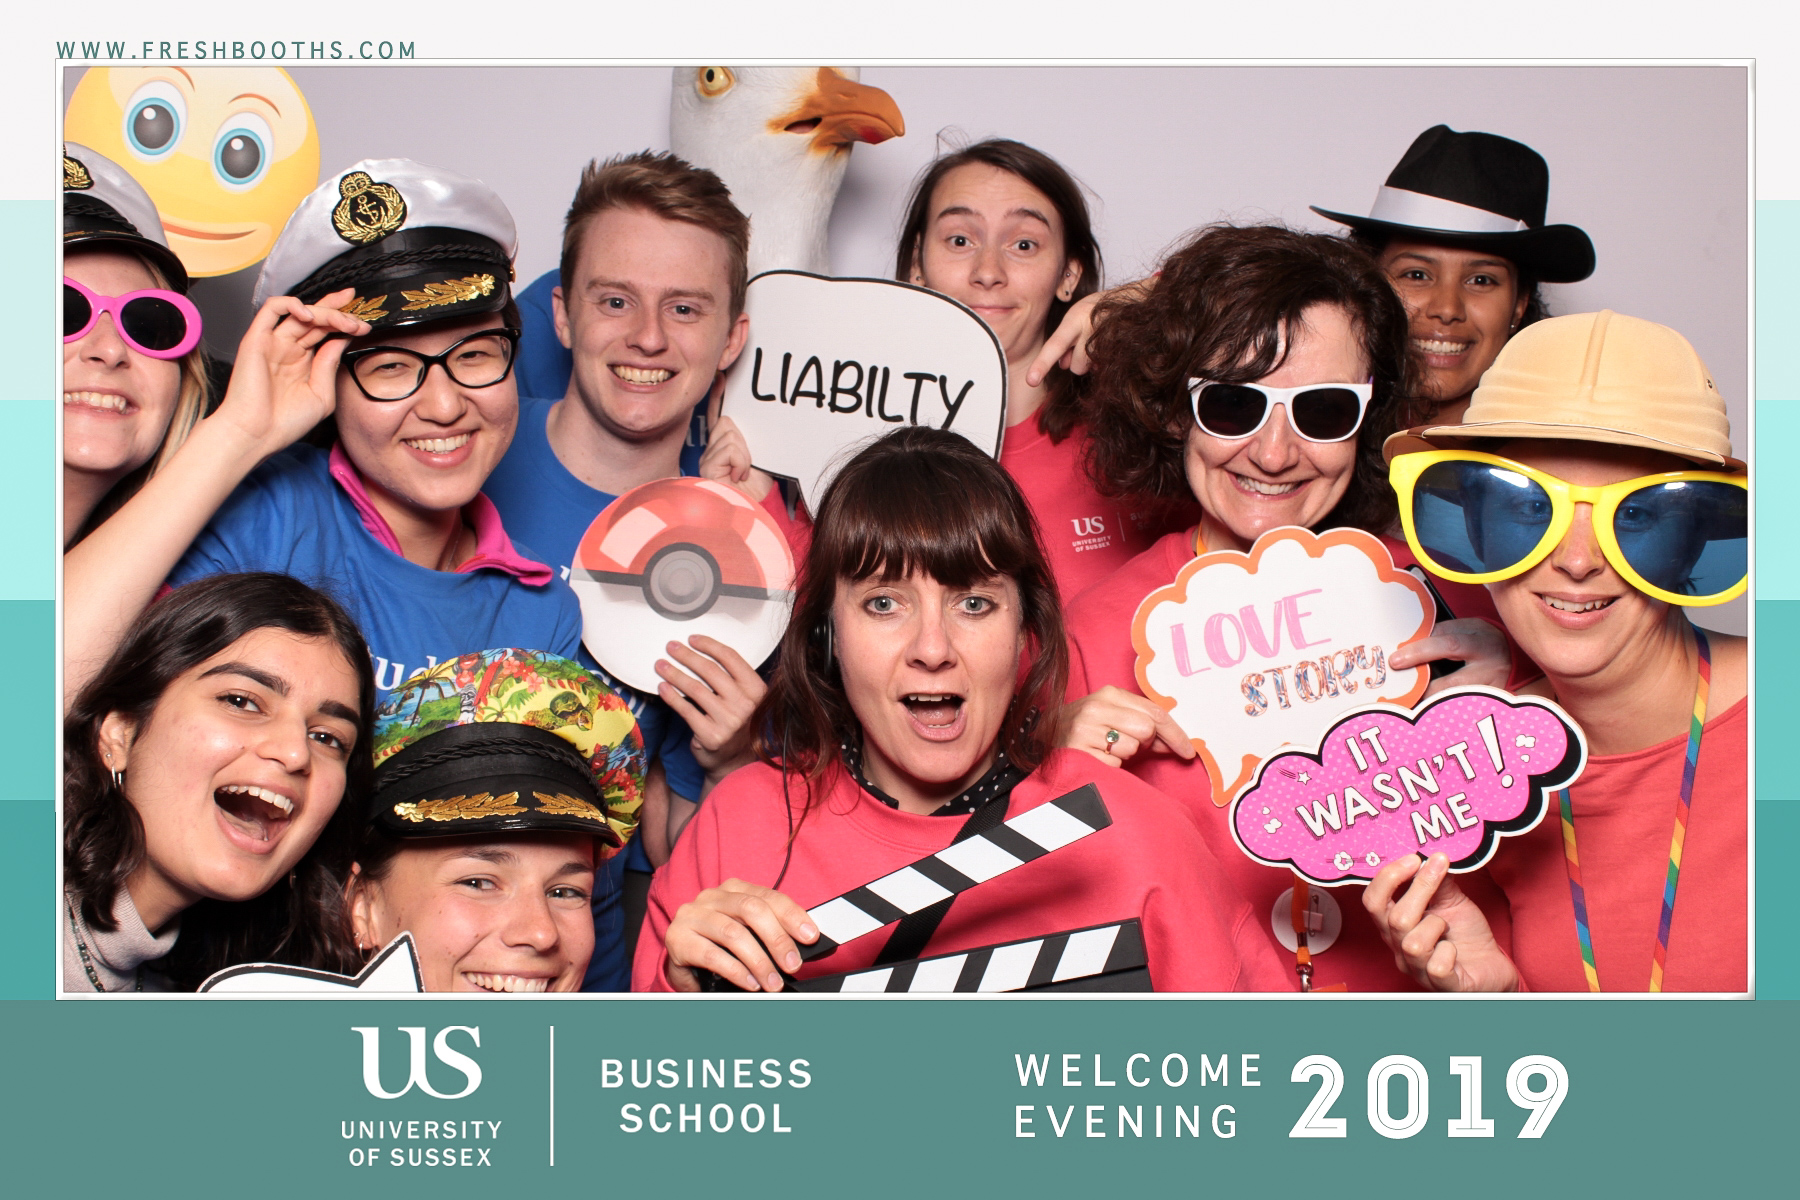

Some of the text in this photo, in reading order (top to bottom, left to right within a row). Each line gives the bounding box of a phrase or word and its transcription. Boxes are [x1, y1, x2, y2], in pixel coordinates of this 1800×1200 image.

[751, 347, 975, 430] LIABILTY
[1072, 535, 1112, 547] UNIVERSITY
[1075, 541, 1110, 553] OF SUSSEX
[1170, 588, 1332, 677] LOVE
[1241, 645, 1386, 717] STORY
[1345, 725, 1389, 774] IT
[1410, 792, 1480, 848] ME
